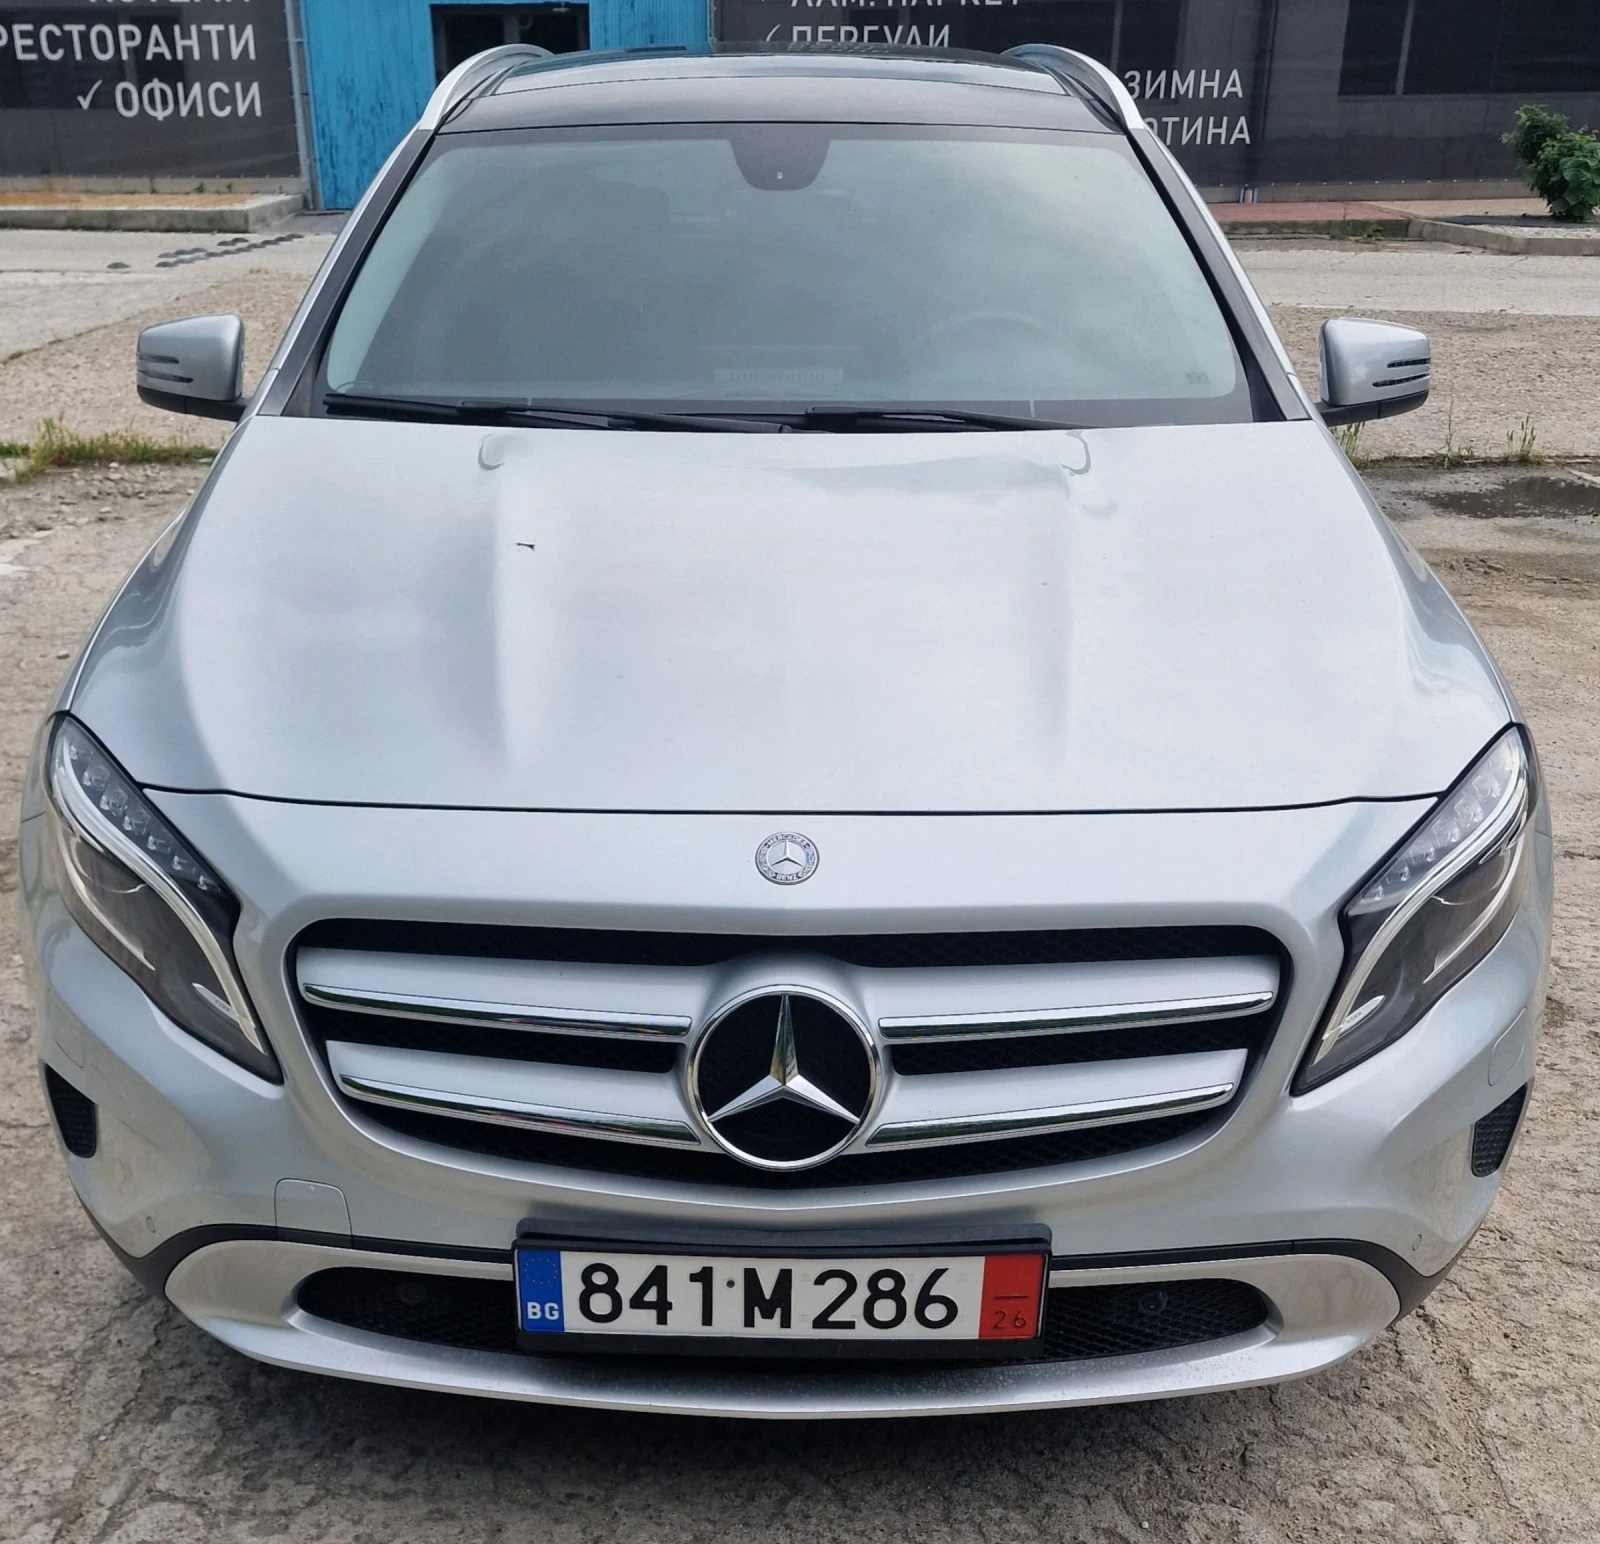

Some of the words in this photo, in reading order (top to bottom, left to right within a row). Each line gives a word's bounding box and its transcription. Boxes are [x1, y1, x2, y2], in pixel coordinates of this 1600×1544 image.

[115, 78, 262, 121] ОФИСИ
[1123, 69, 1243, 100] ЗИМНА
[527, 1302, 559, 1320] BG
[579, 1263, 714, 1326] 841
[744, 1268, 792, 1328] M
[812, 1268, 958, 1329] 286
[993, 1310, 1027, 1329] 26
